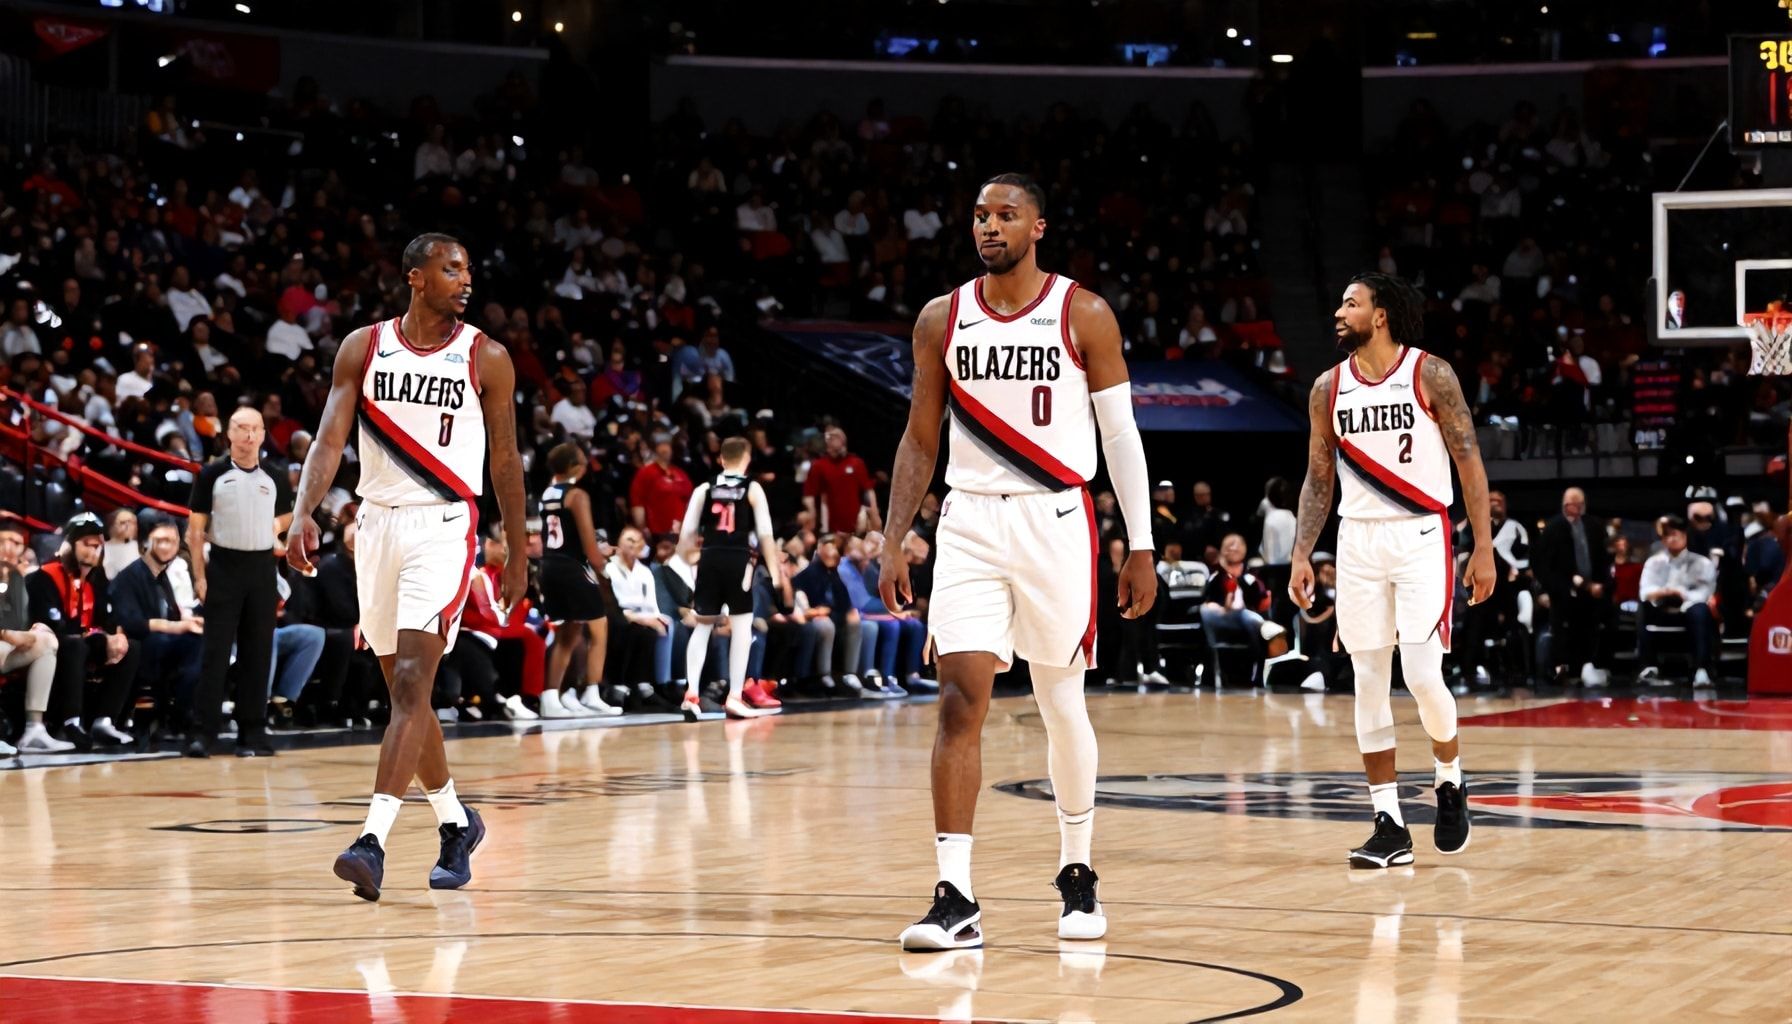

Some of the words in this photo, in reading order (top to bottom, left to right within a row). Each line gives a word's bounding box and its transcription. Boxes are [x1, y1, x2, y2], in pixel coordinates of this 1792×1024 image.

[956, 345, 1061, 382] BLAZERS
[1031, 385, 1053, 427] 0
[1398, 433, 1413, 464] 2
